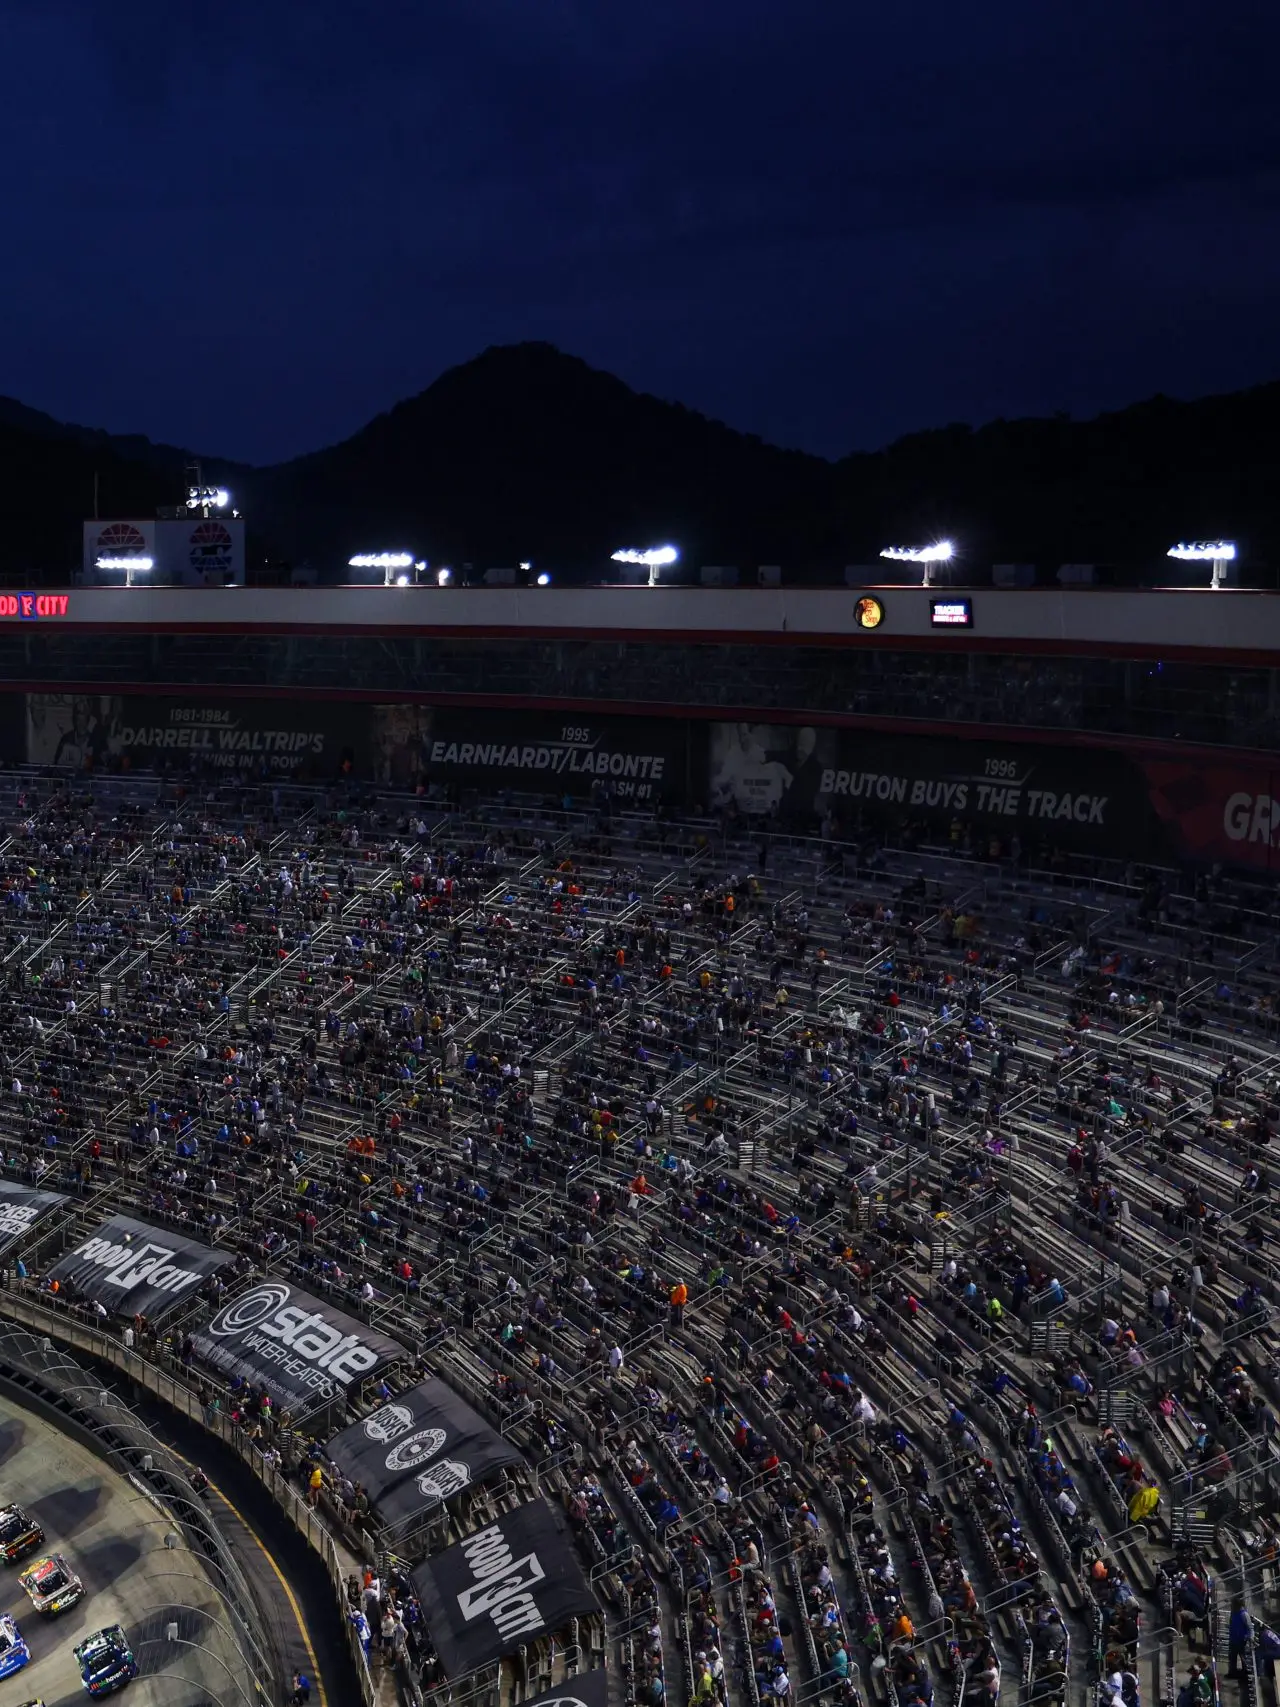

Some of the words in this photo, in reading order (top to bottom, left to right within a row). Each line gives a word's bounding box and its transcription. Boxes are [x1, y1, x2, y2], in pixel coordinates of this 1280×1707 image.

[36, 595, 69, 616] CITY
[168, 708, 230, 723] 1981-1984
[120, 727, 214, 750] DARRELL
[218, 730, 325, 754] WALTRIP'S
[560, 726, 590, 743] 1995
[238, 754, 254, 768] IN
[429, 740, 666, 780] EARNHARDT/LABONTE
[983, 757, 1017, 778] 1996
[820, 768, 909, 803] BRUTON
[910, 779, 969, 811] BUYS
[976, 785, 1021, 816] THE
[1026, 789, 1108, 825] TRACK
[1223, 791, 1280, 848] GR
[72, 1236, 133, 1269] FOOD
[145, 1261, 204, 1294] CITY
[240, 1330, 289, 1367] WATER
[258, 1305, 379, 1385] state
[367, 1406, 409, 1440] BUSH'S
[421, 1462, 465, 1496] BUSH'S
[459, 1524, 514, 1580] FOOD
[488, 1591, 547, 1643] CITY
